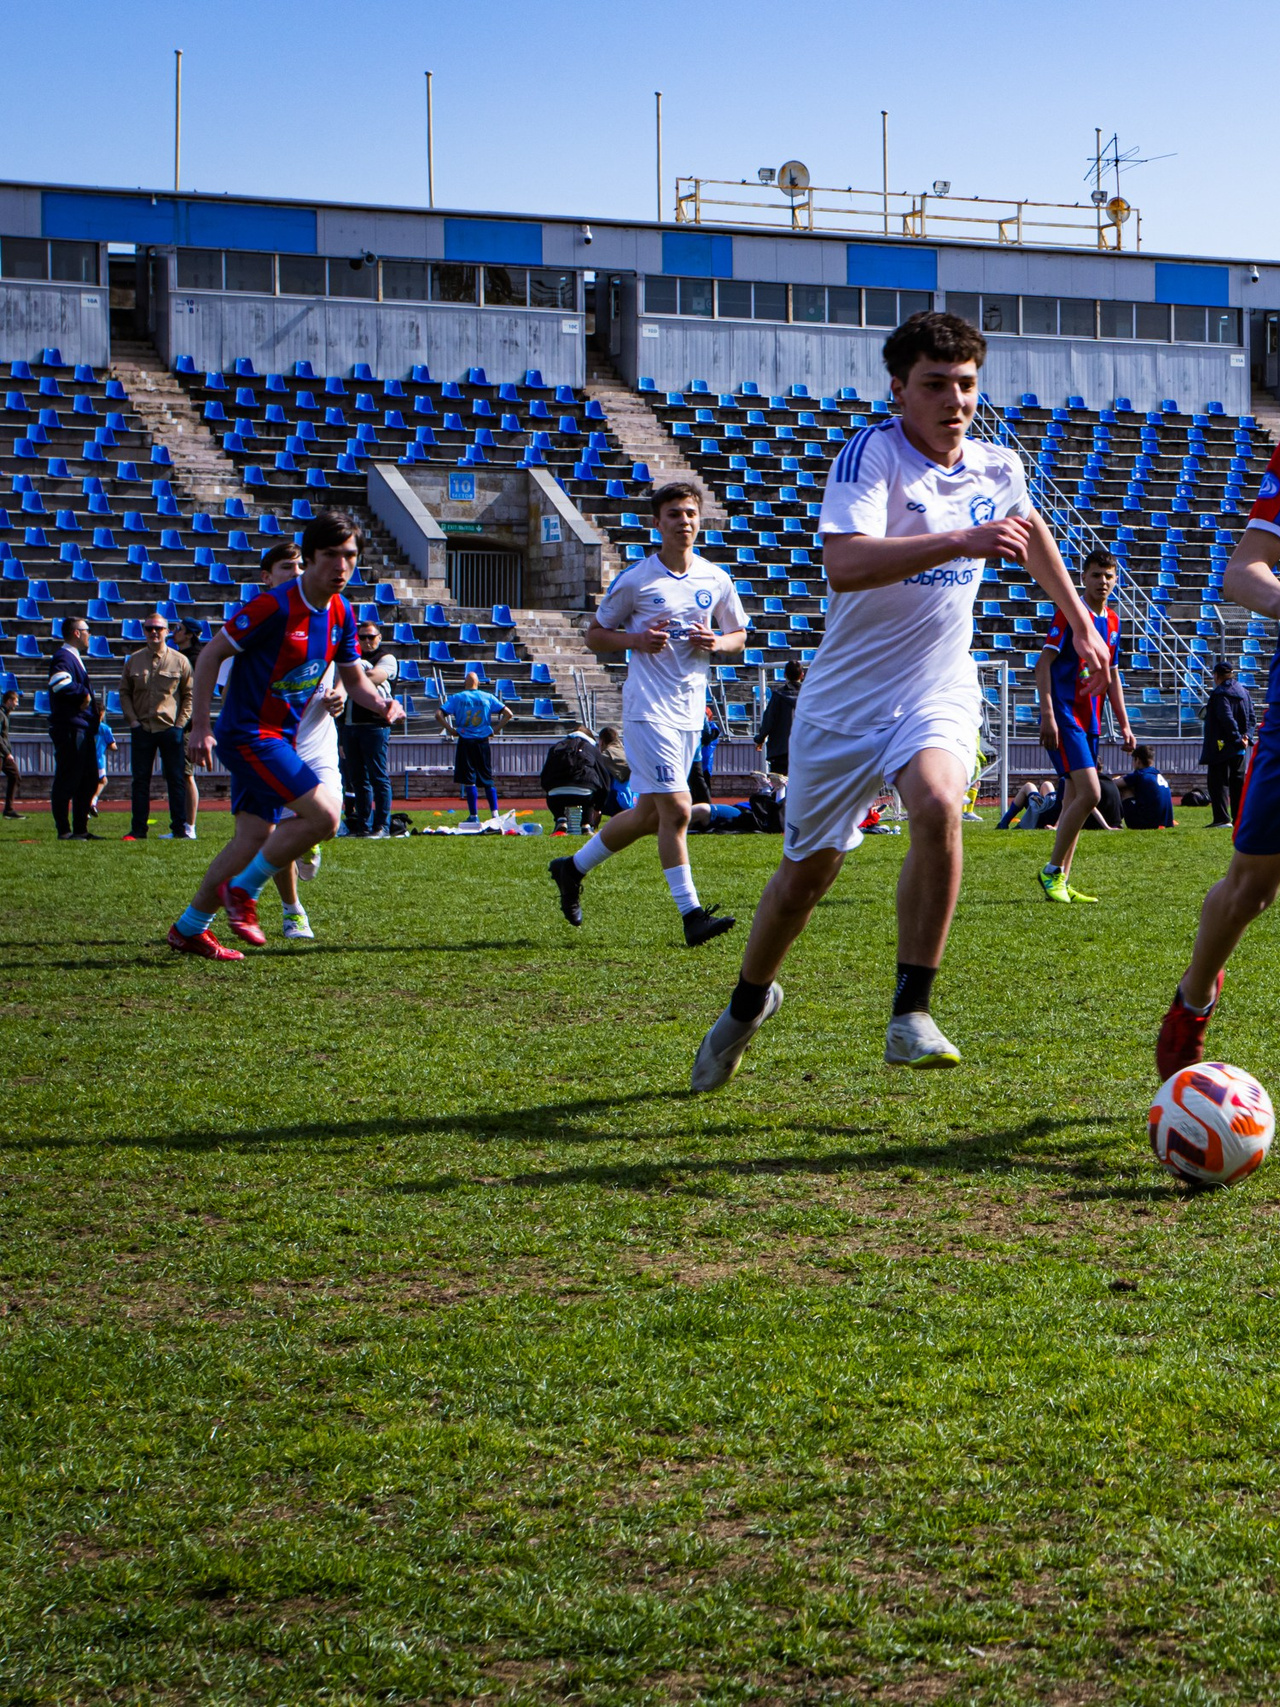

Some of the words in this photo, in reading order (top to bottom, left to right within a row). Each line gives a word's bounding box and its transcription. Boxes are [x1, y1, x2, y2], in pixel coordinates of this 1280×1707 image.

[453, 479, 471, 493] 10
[656, 765, 675, 782] 10
[787, 822, 800, 847] 7
